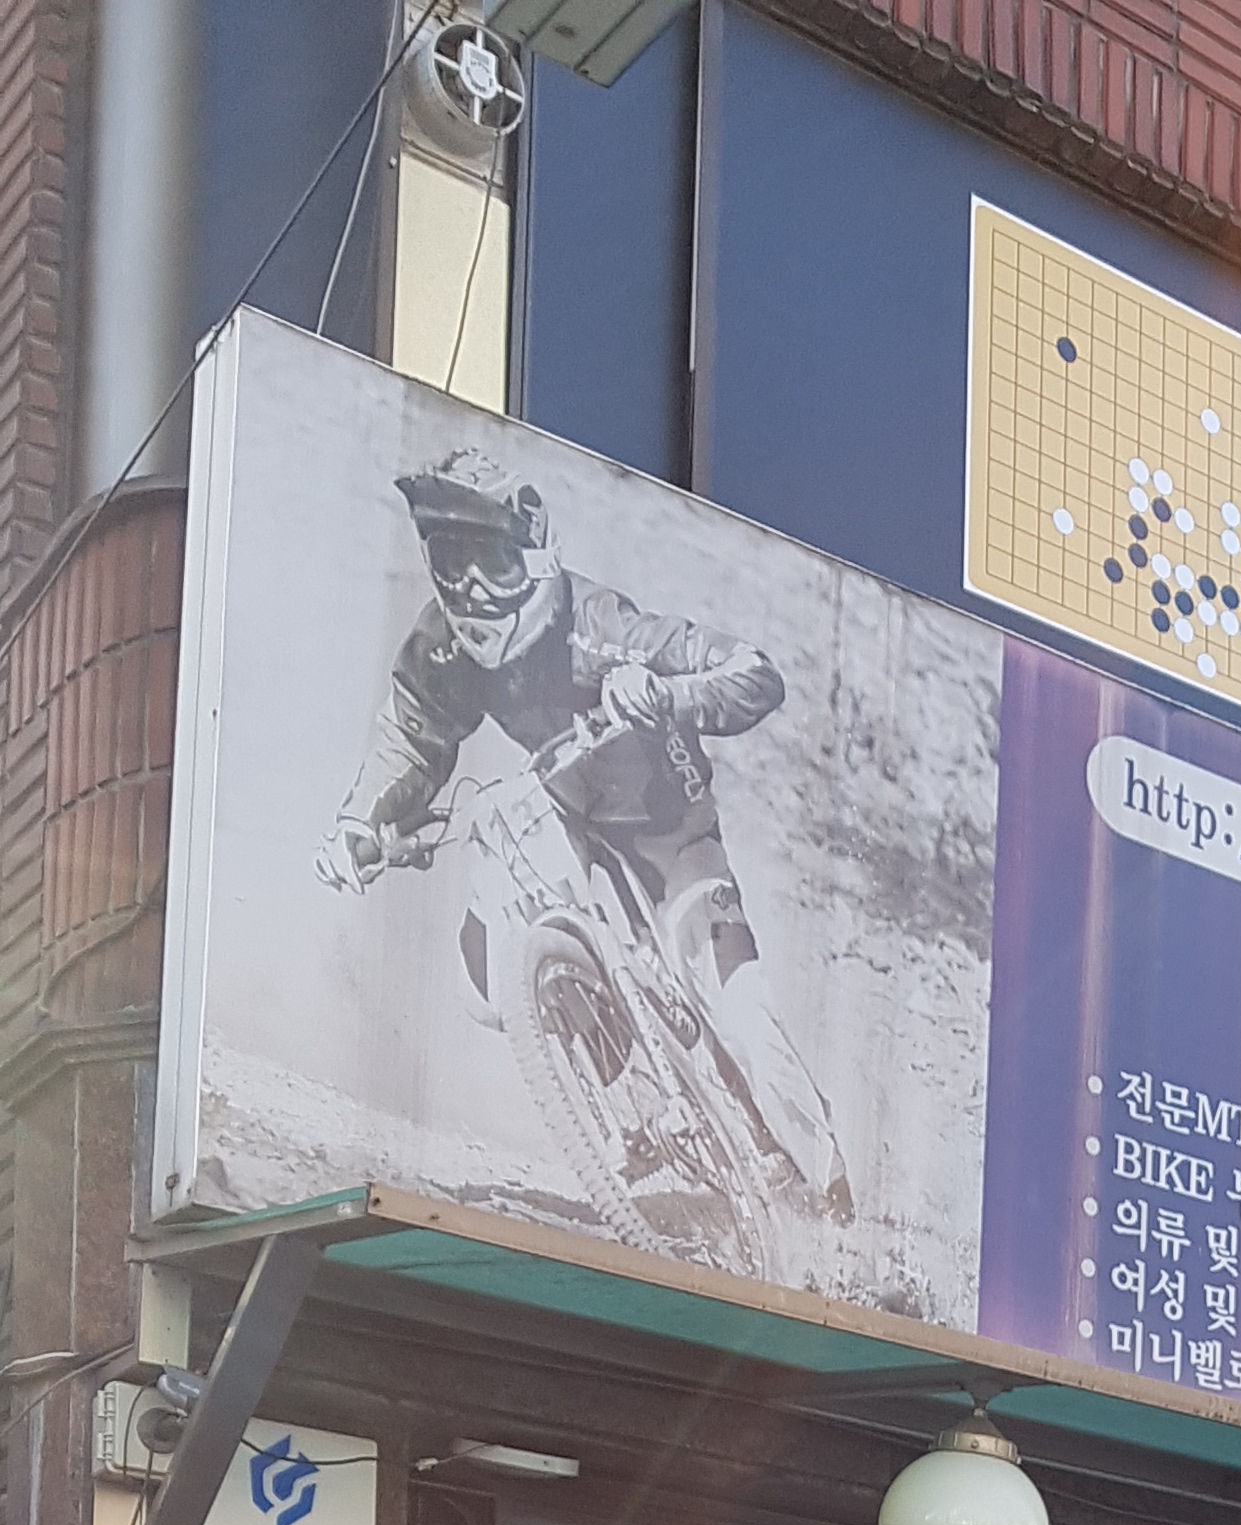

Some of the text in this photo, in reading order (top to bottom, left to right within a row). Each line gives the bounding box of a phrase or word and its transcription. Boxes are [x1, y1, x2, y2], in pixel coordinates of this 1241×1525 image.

[1112, 1134, 1214, 1201] BIKE
[1112, 1198, 1191, 1262] 의류
[1206, 1225, 1239, 1277] 및
[1111, 1260, 1185, 1321] 여성
[1204, 1284, 1236, 1337] 및
